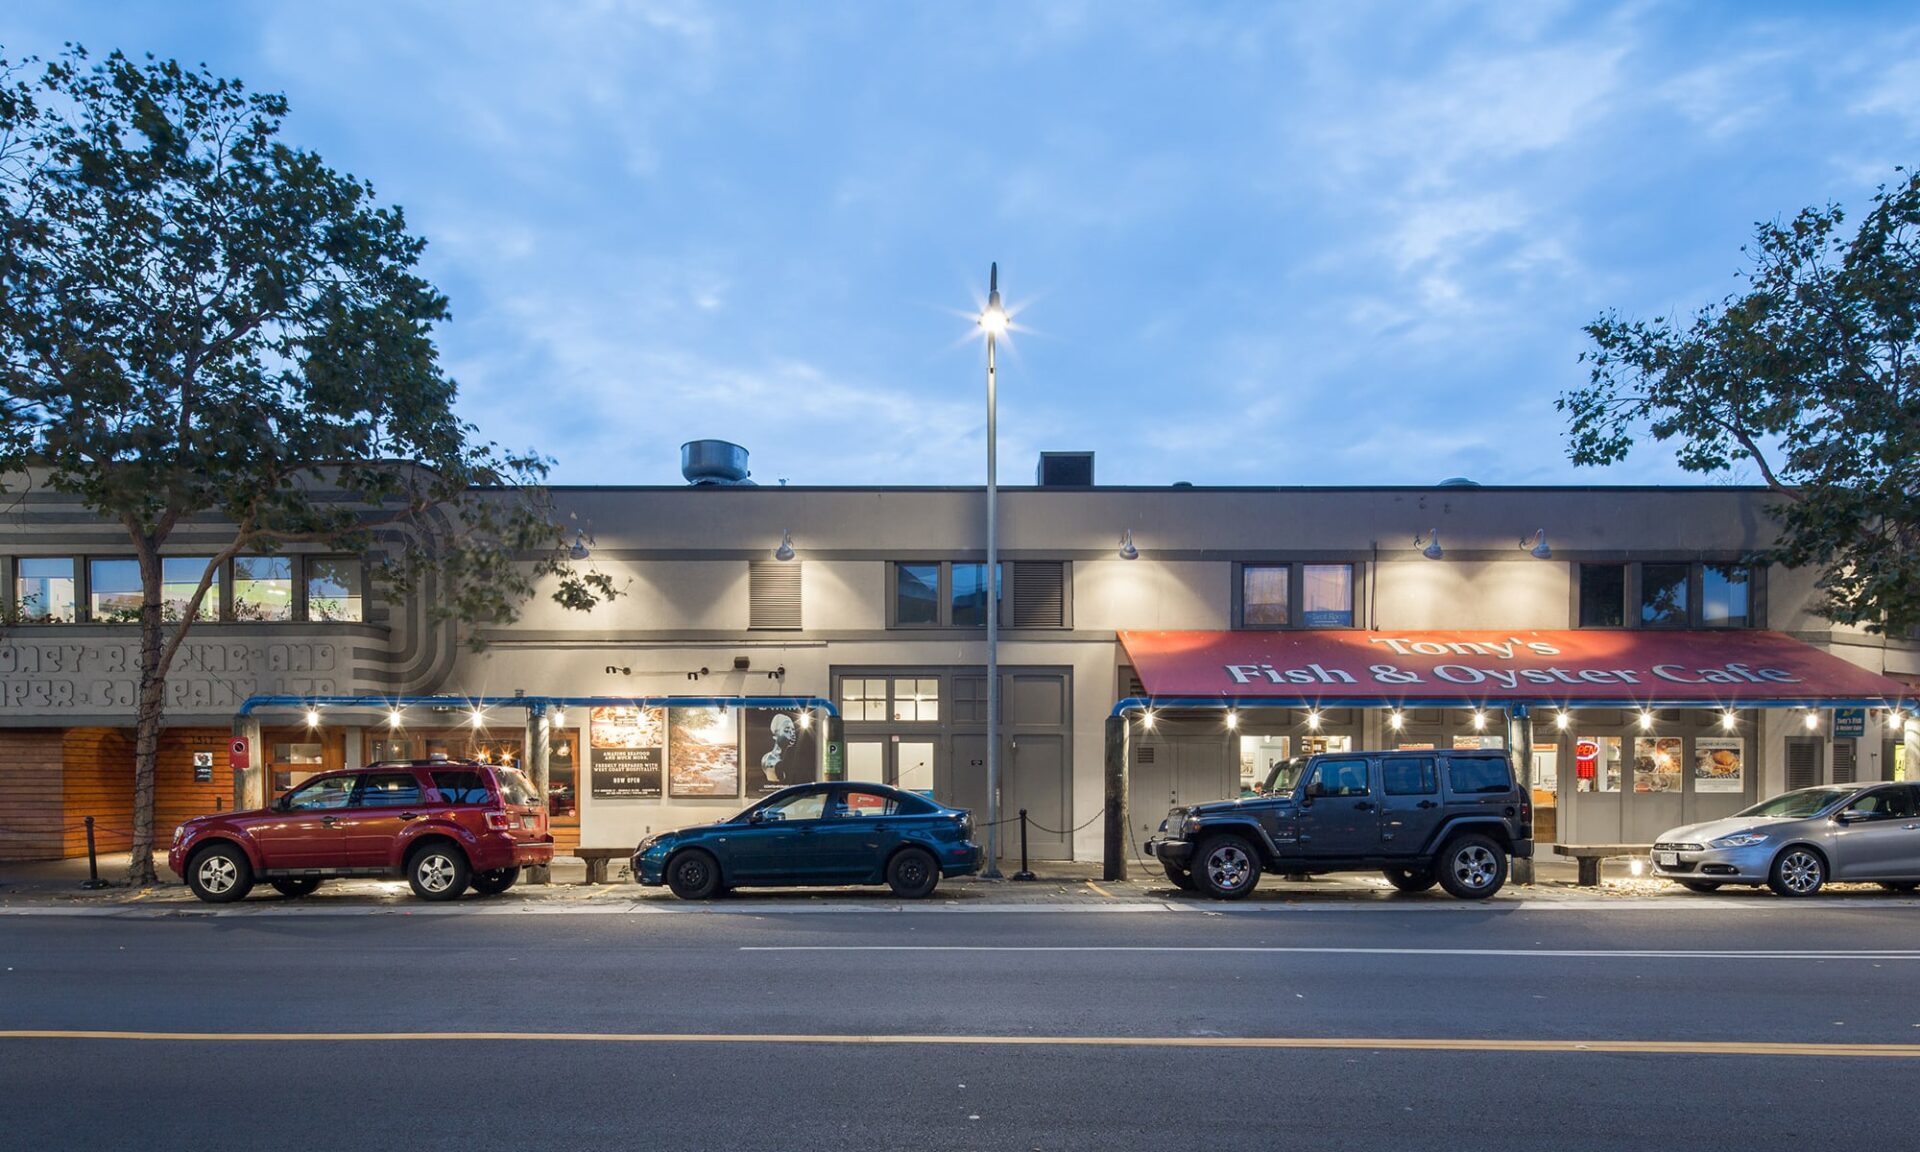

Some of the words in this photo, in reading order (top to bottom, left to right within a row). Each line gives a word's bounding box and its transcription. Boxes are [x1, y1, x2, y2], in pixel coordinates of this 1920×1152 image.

[1368, 632, 1561, 659] Tony's
[1225, 663, 1359, 685] Fish
[1369, 664, 1428, 685] &
[1433, 664, 1642, 689] Oyster
[1650, 662, 1803, 685] Cafe
